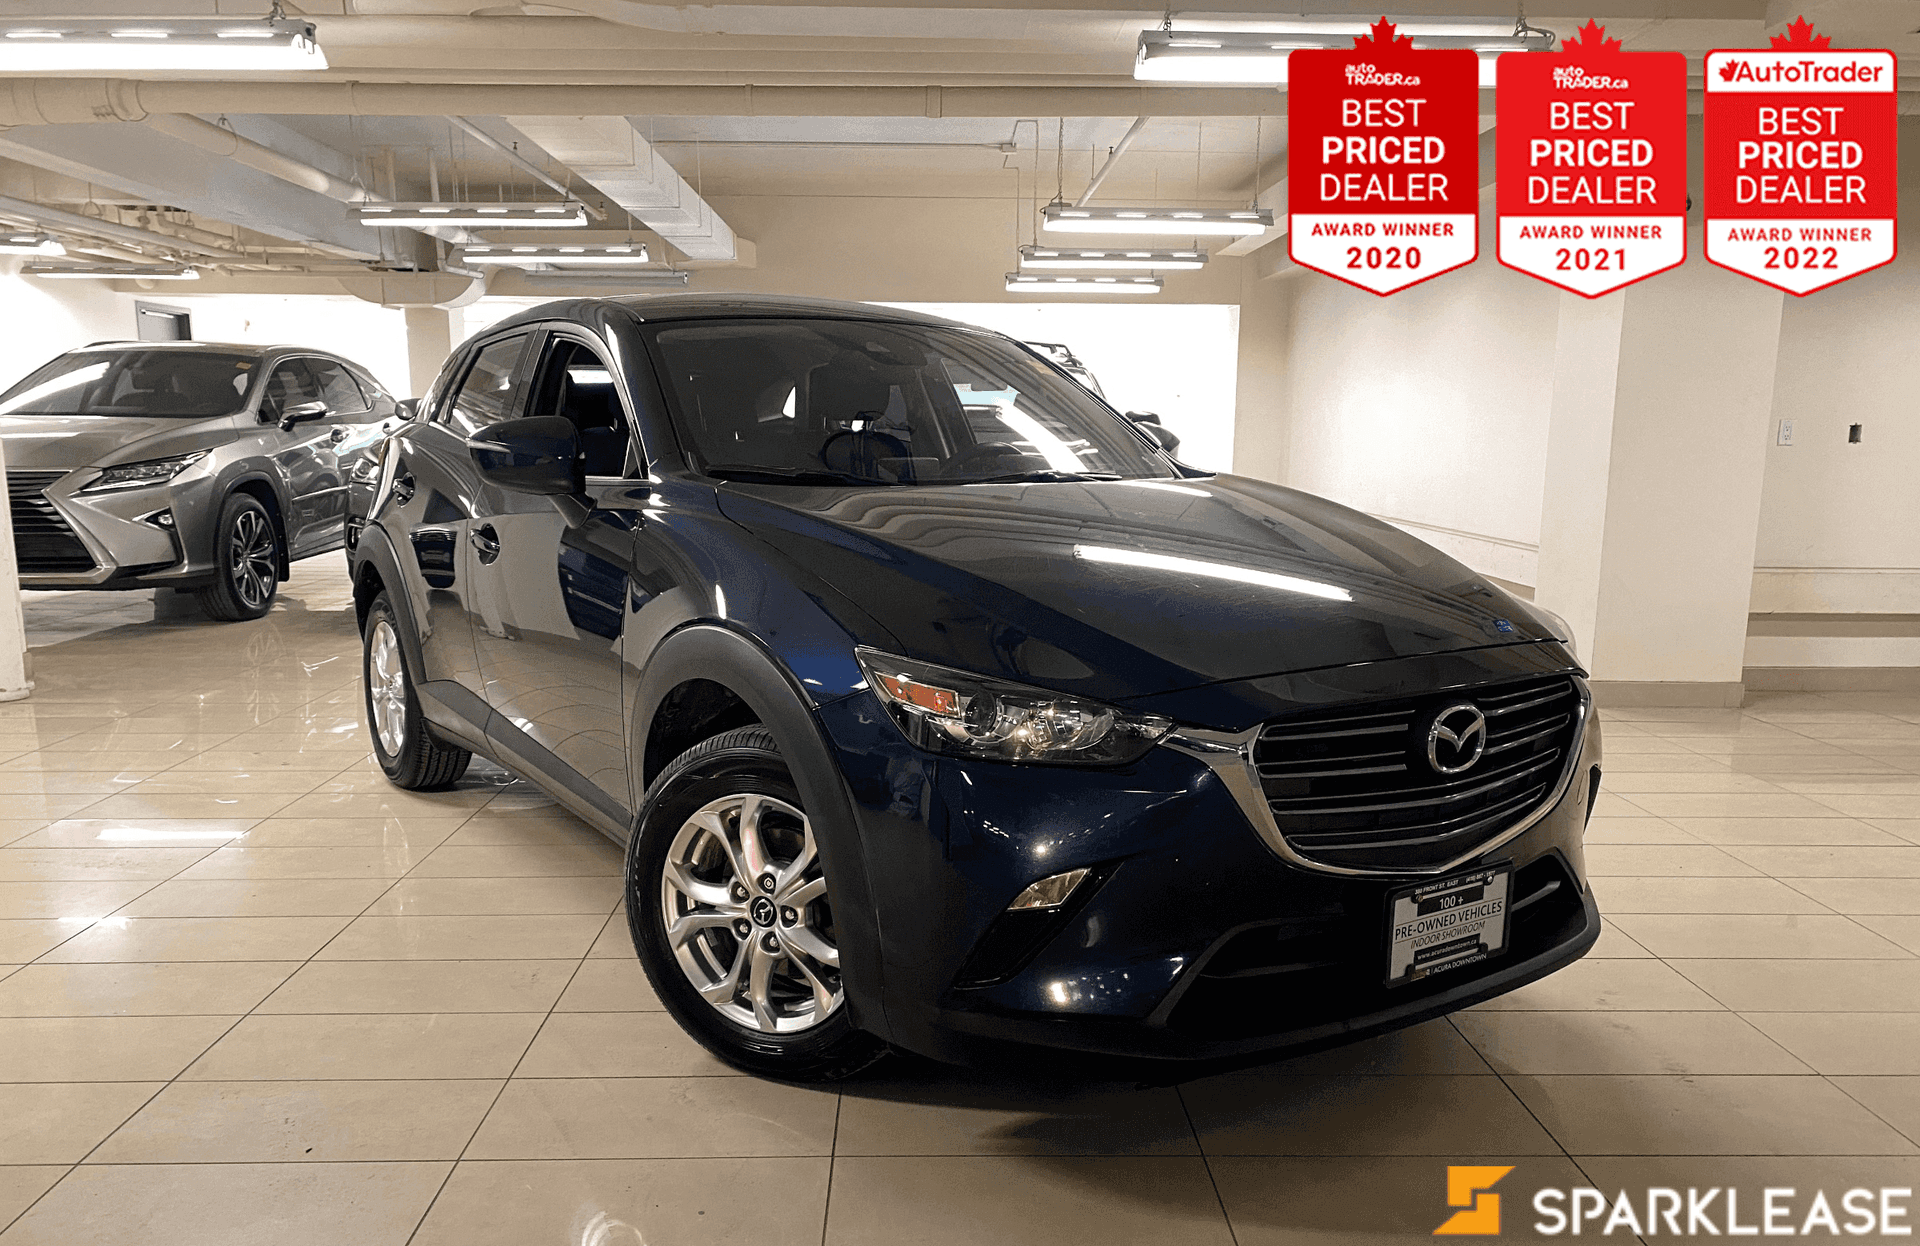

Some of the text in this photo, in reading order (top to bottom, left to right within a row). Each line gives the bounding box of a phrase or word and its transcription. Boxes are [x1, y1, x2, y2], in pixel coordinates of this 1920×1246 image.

[1423, 884, 1439, 893] FRONT
[1447, 879, 1459, 887] EAST
[1440, 895, 1456, 909] 100
[1395, 901, 1503, 940] PRE-OWNED VEHICLES
[1411, 920, 1485, 950] INDOOR SHOWROOM
[1433, 953, 1487, 974] ACURA DOWNTOWN
